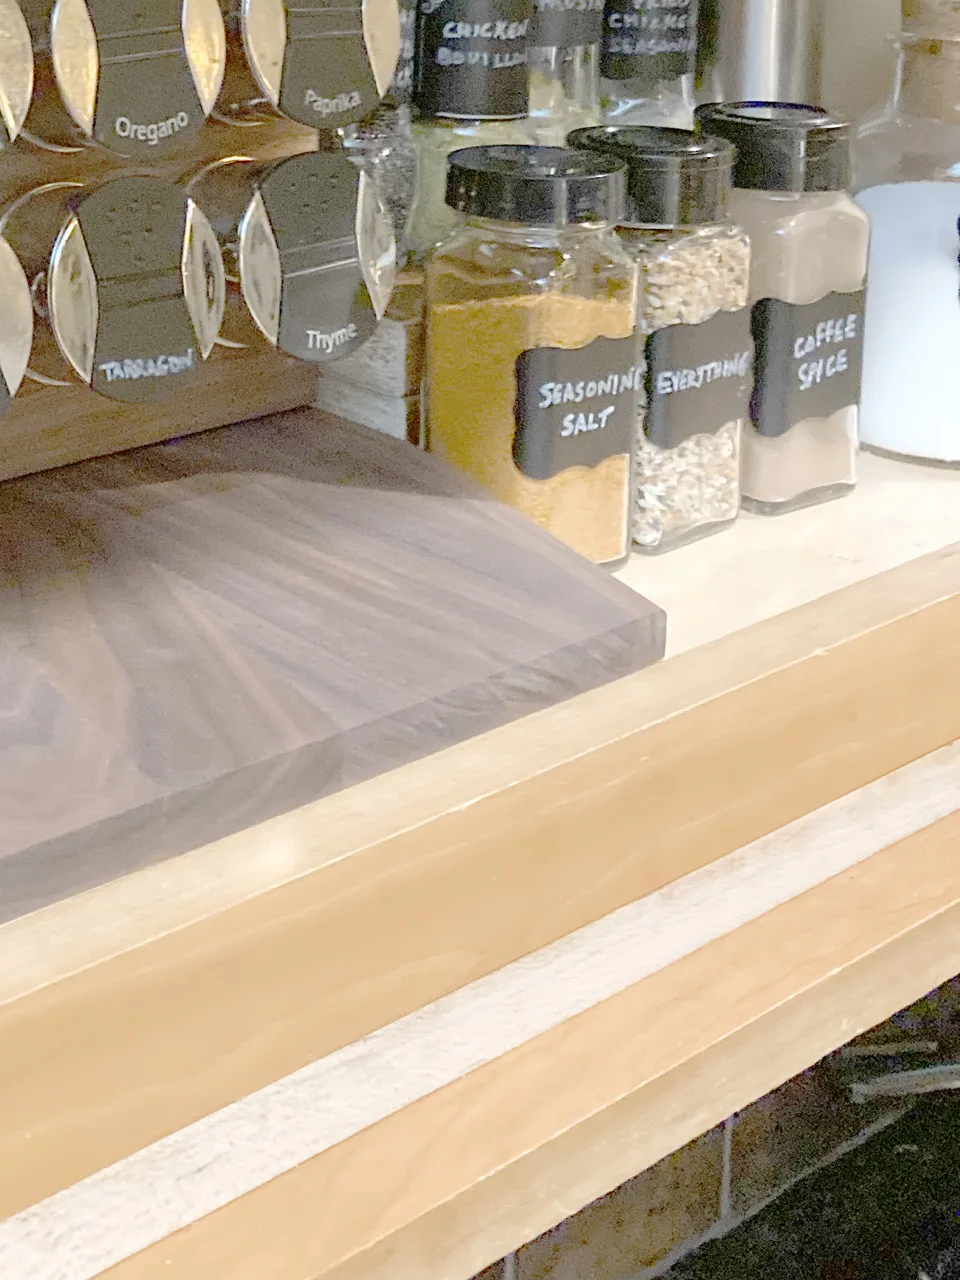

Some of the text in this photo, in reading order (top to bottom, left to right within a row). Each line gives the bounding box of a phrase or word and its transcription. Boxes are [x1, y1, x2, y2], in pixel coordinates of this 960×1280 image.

[304, 89, 362, 118] Paprika
[115, 111, 189, 145] Oregano
[305, 323, 360, 354] Thyme
[793, 313, 858, 360] COFFEE
[797, 347, 849, 392] SPICE
[560, 405, 616, 437] SALT
